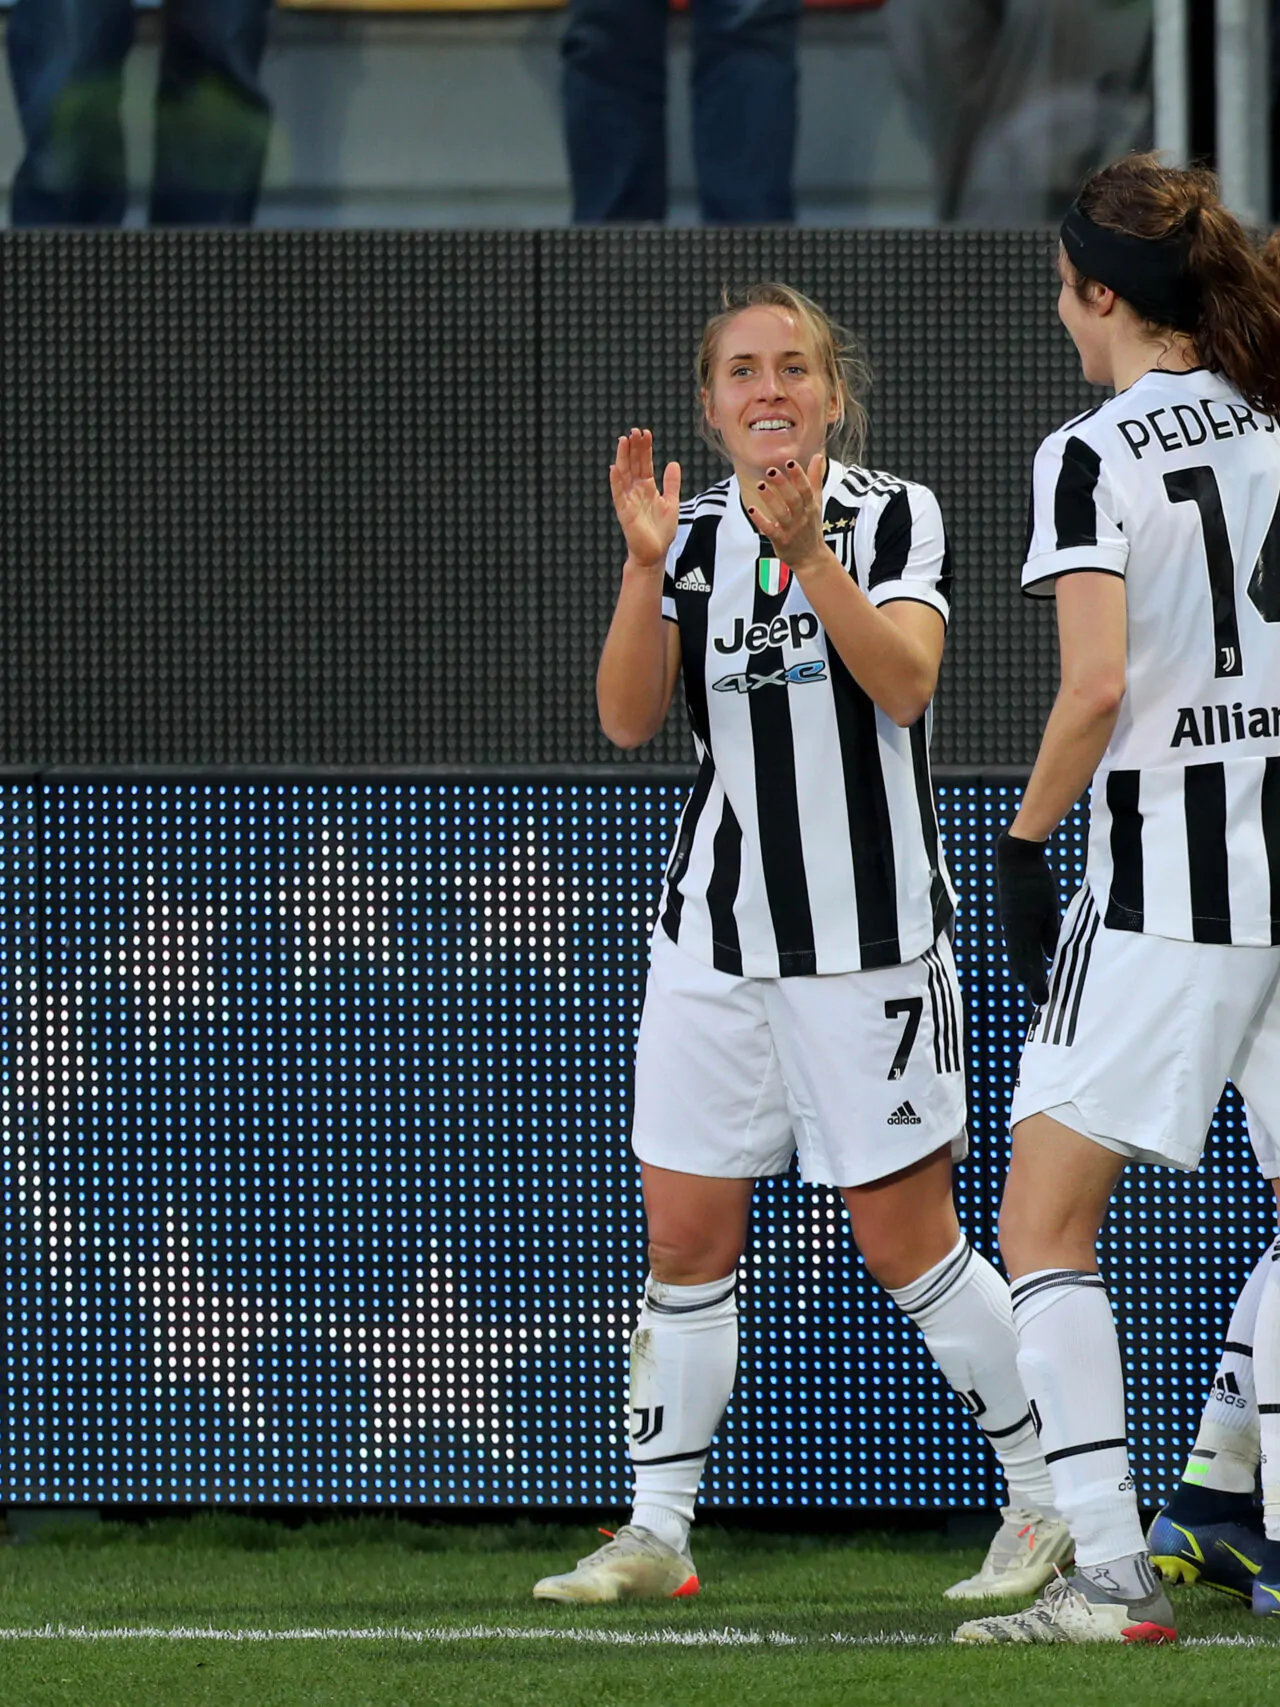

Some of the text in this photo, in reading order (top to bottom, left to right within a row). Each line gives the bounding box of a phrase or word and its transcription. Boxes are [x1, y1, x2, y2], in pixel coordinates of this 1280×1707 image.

[675, 579, 711, 593] adidas
[713, 611, 819, 655] Jeep
[884, 996, 923, 1081] 7
[887, 1115, 922, 1126] adidas
